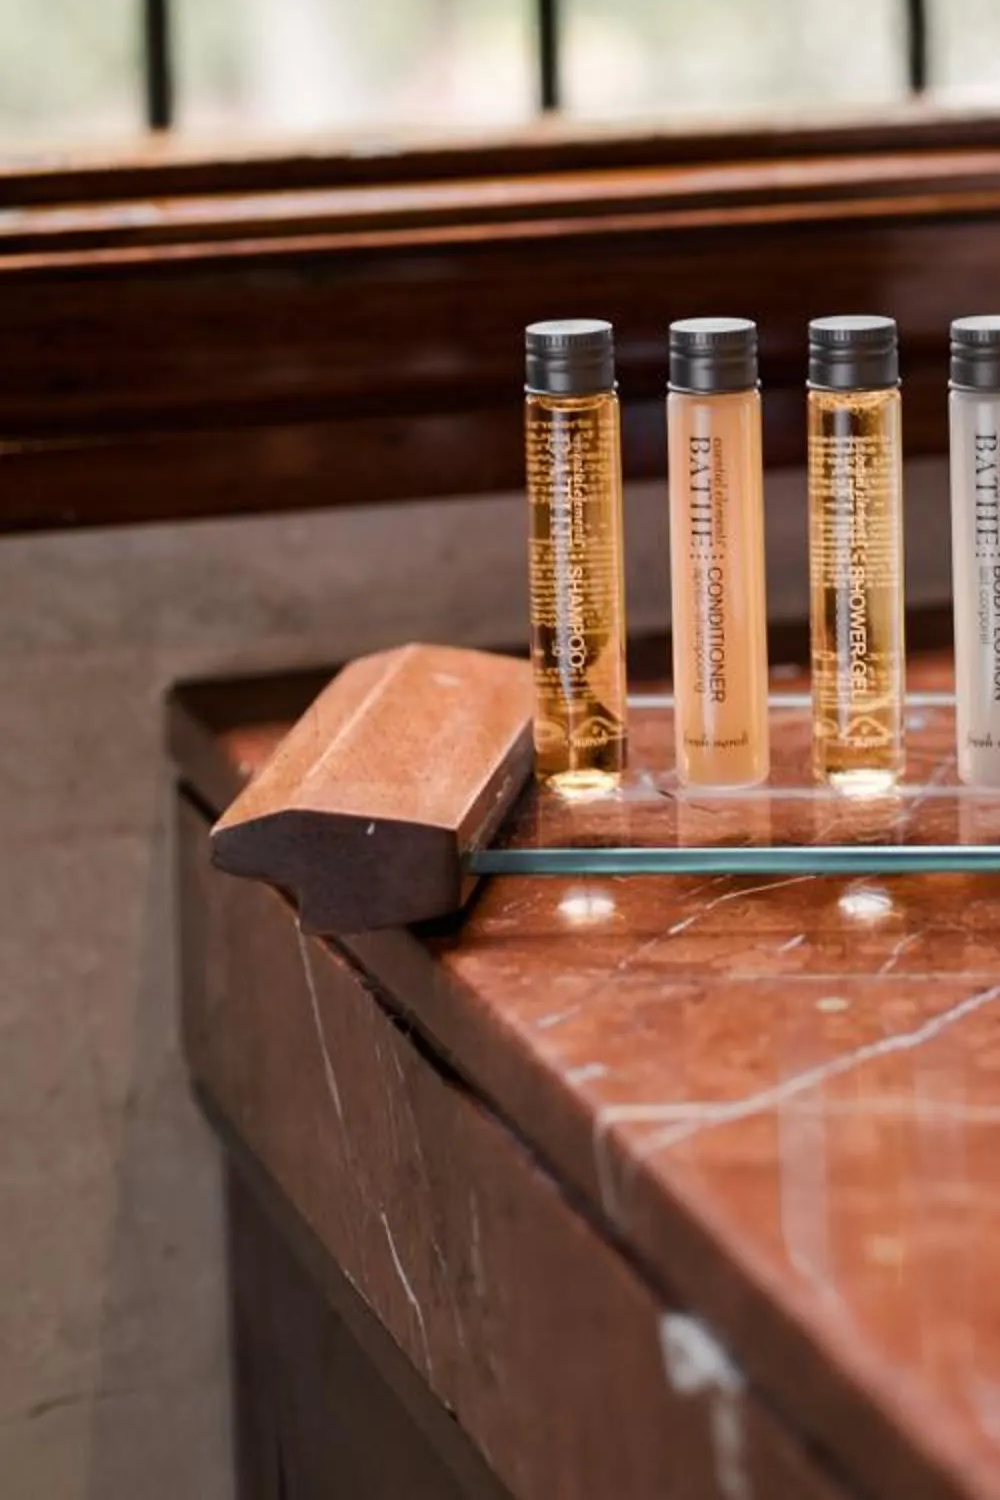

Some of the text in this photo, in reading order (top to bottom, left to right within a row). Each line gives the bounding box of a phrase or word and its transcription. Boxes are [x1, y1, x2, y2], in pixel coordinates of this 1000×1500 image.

[689, 435, 711, 547] BATHE
[975, 434, 998, 546] BATHE
[567, 565, 586, 668] SHAMPOO
[707, 566, 727, 704] CONDITIONER
[849, 565, 868, 701] SHOWER GEL
